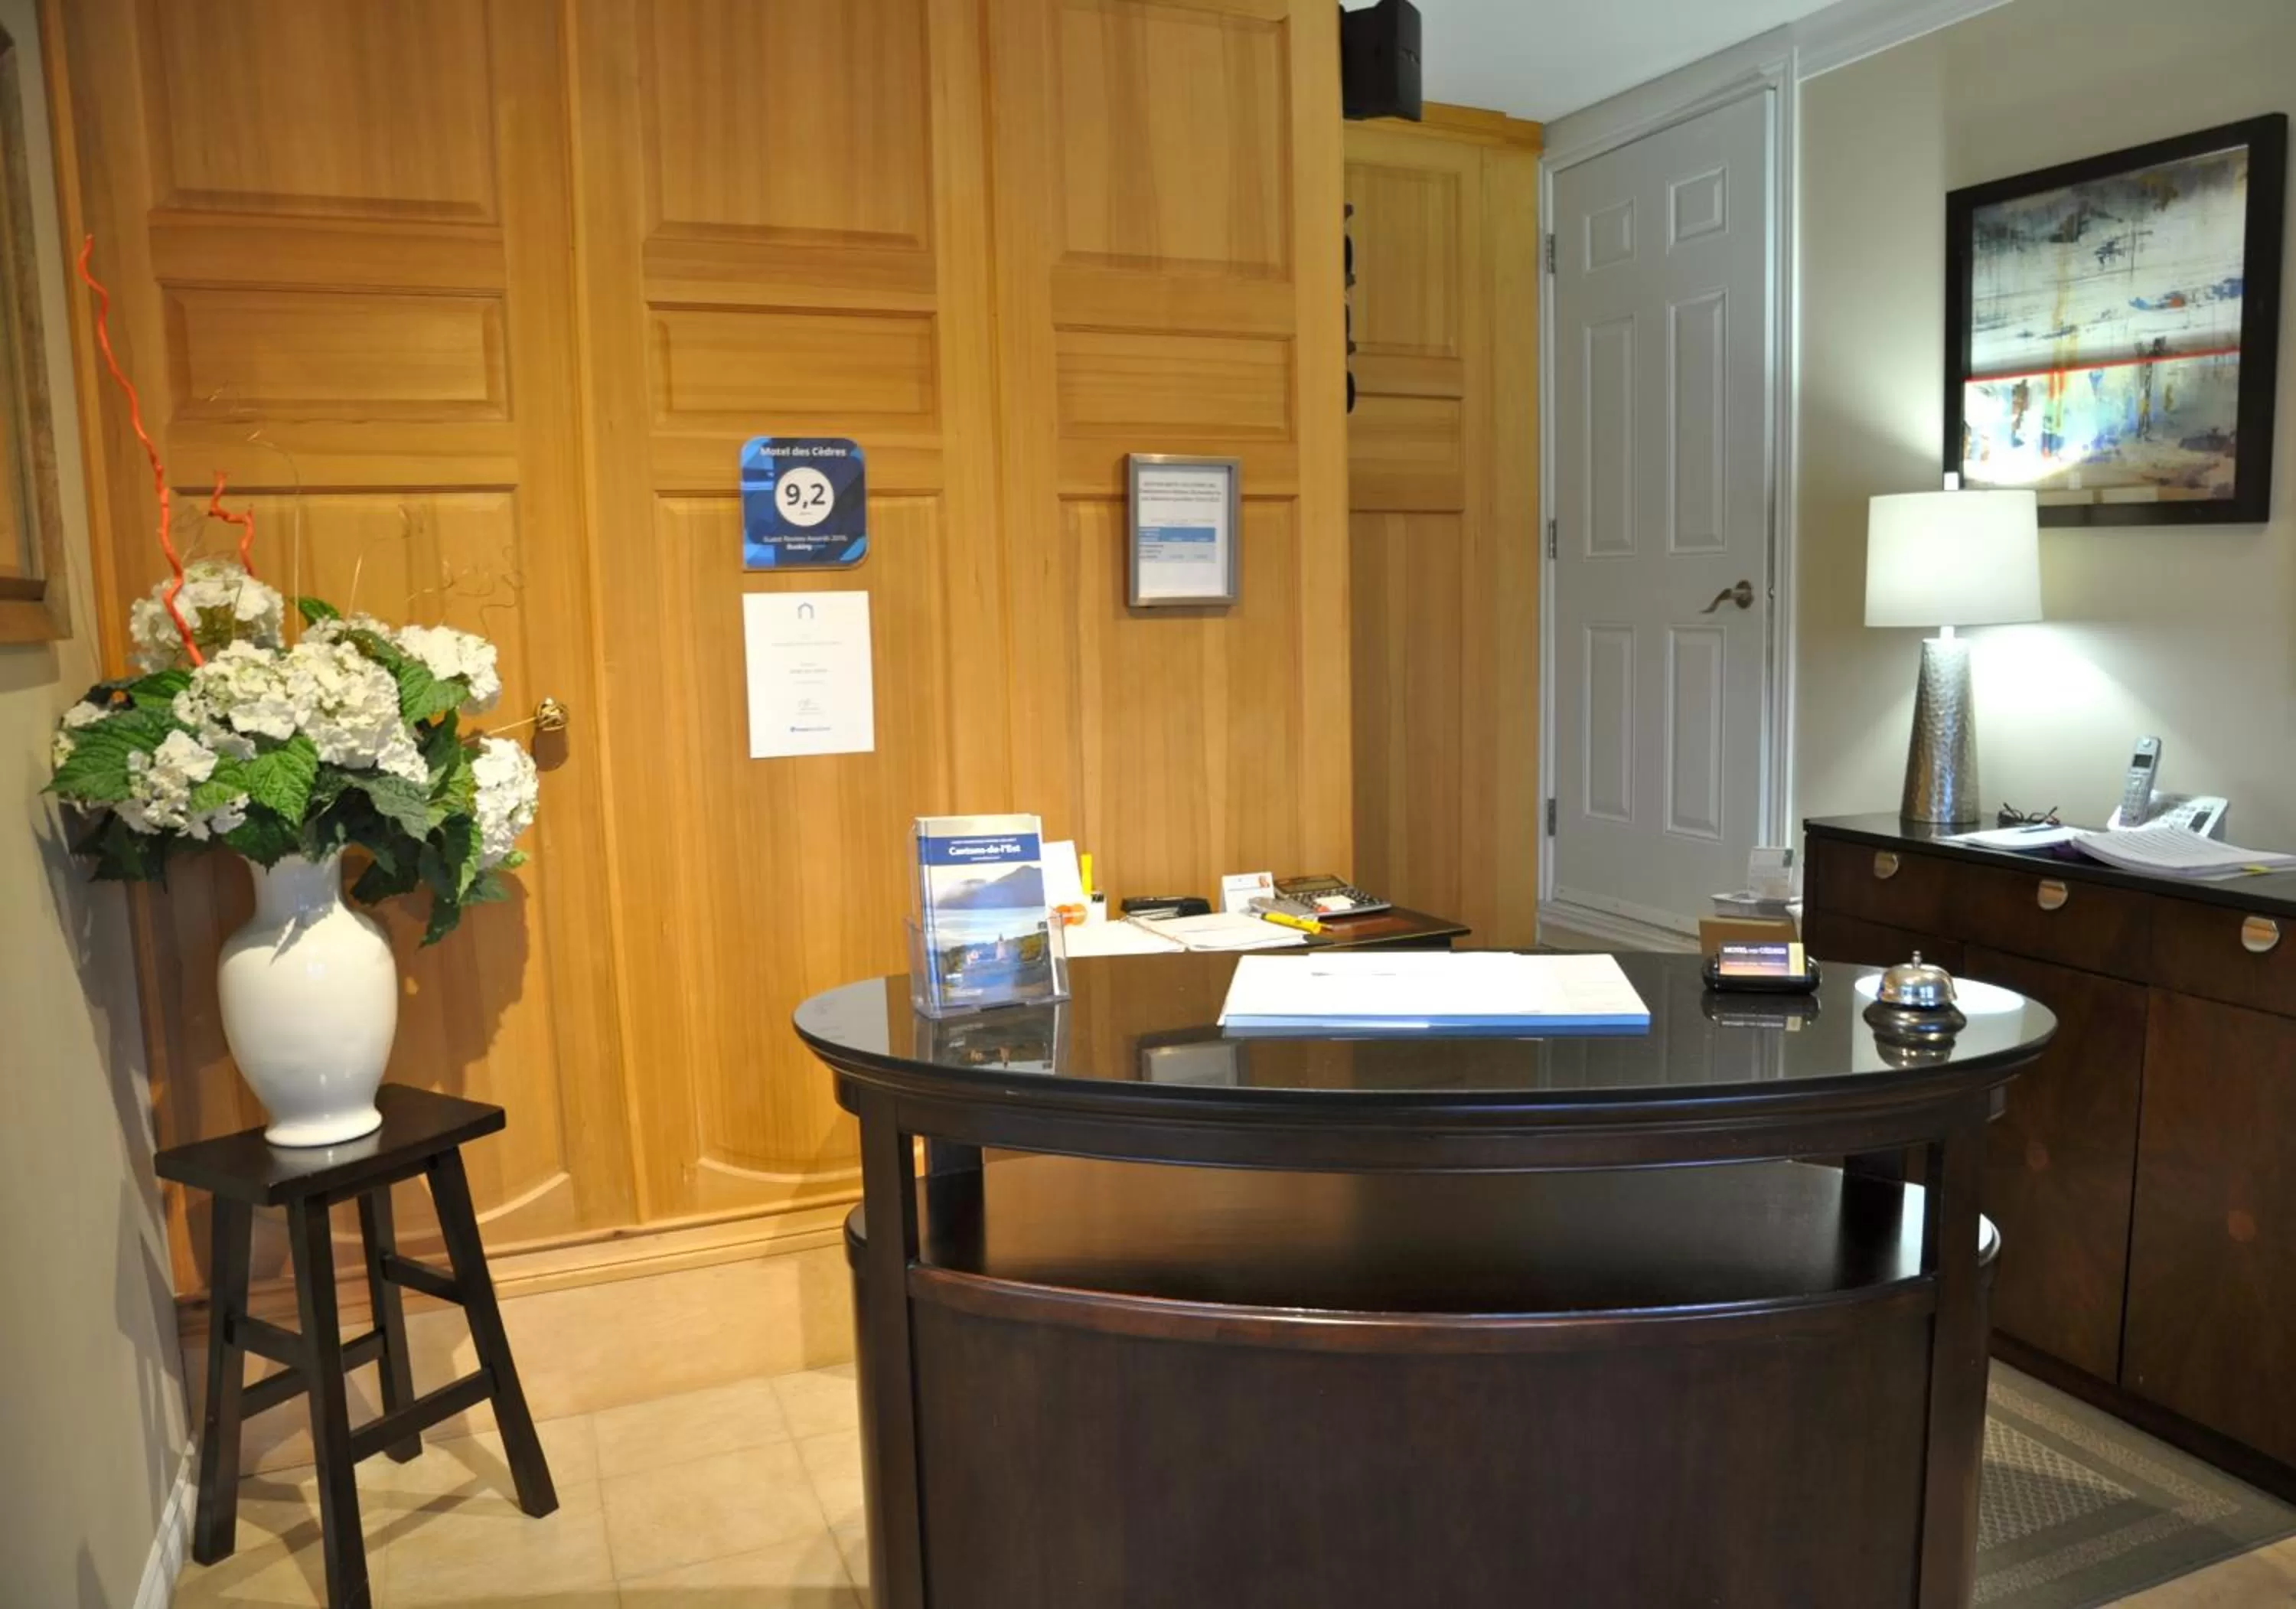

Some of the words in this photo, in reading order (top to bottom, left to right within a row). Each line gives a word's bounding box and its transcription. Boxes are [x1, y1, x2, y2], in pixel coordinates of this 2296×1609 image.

[760, 447, 791, 457] Motel
[792, 447, 810, 457] des
[785, 483, 827, 509] 9,2
